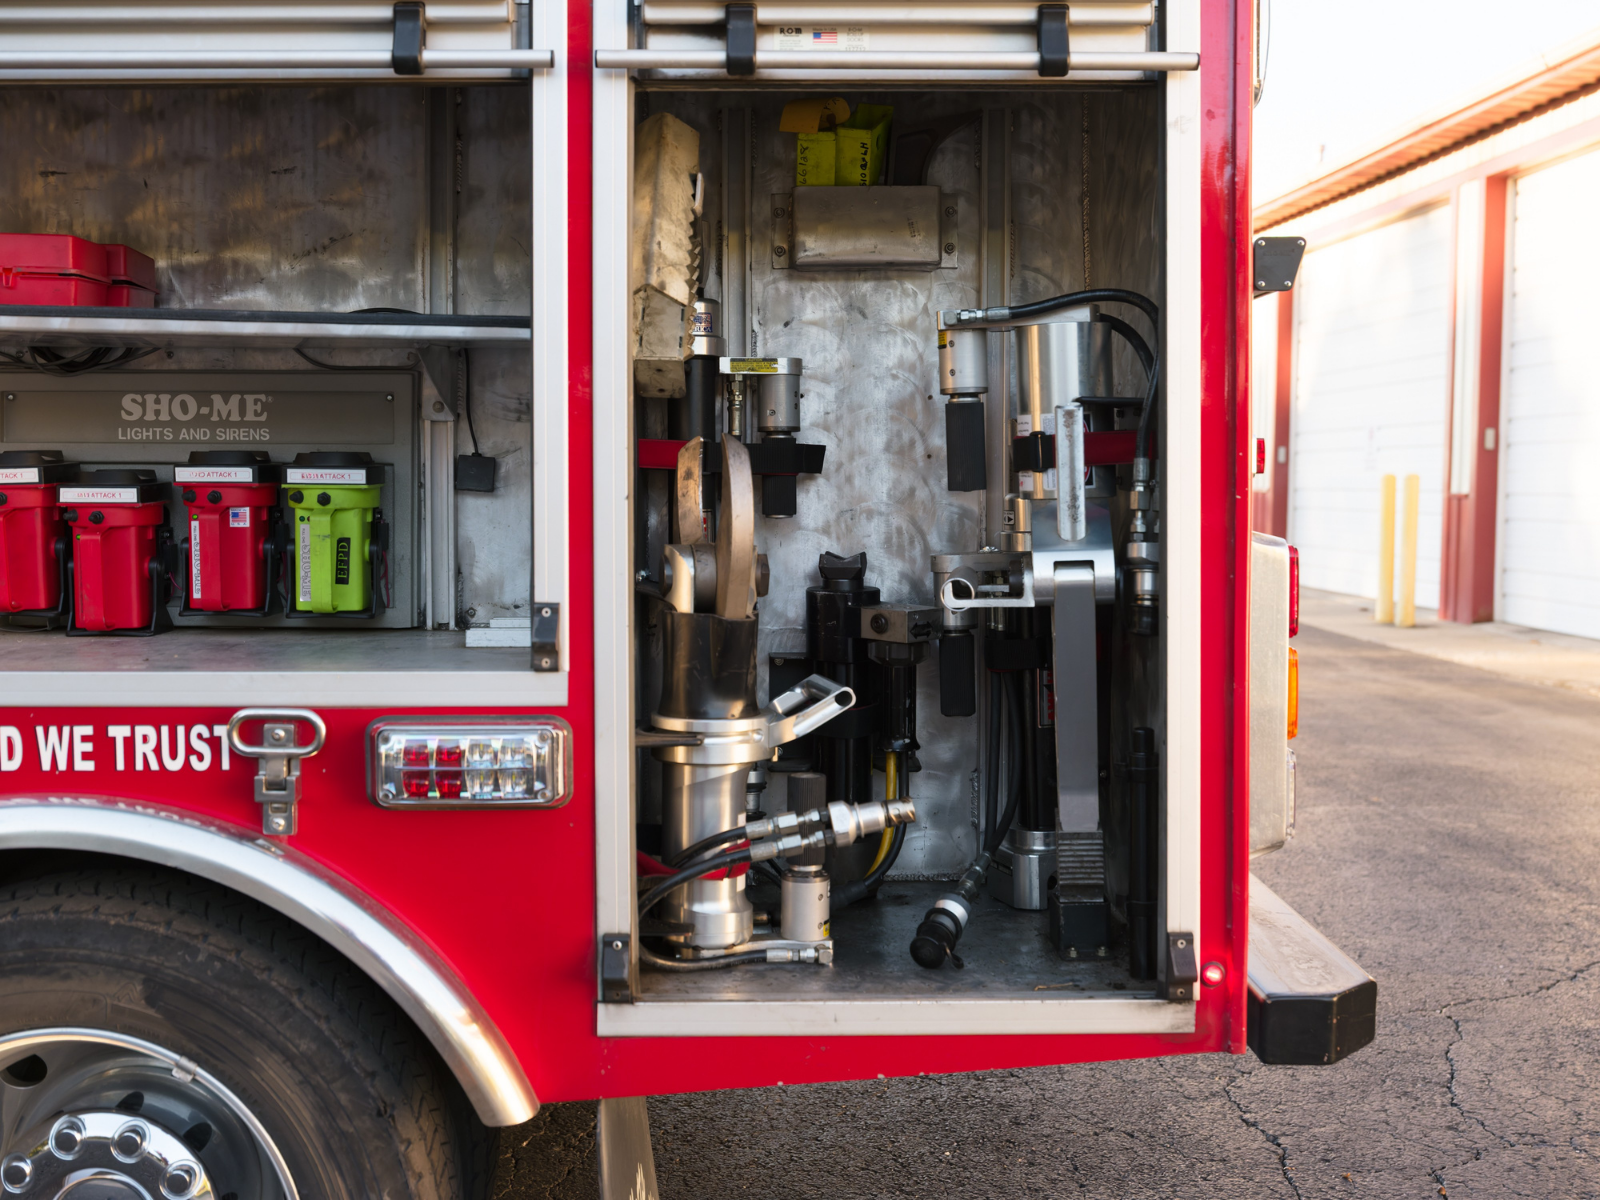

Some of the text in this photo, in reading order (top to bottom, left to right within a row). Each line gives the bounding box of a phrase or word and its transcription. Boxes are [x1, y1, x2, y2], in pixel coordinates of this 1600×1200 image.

[121, 394, 268, 421] SHO-ME
[118, 428, 270, 441] LIGHTS AND SIRENS
[337, 542, 349, 578] EFPD
[0, 724, 230, 772] D WE TRUST
